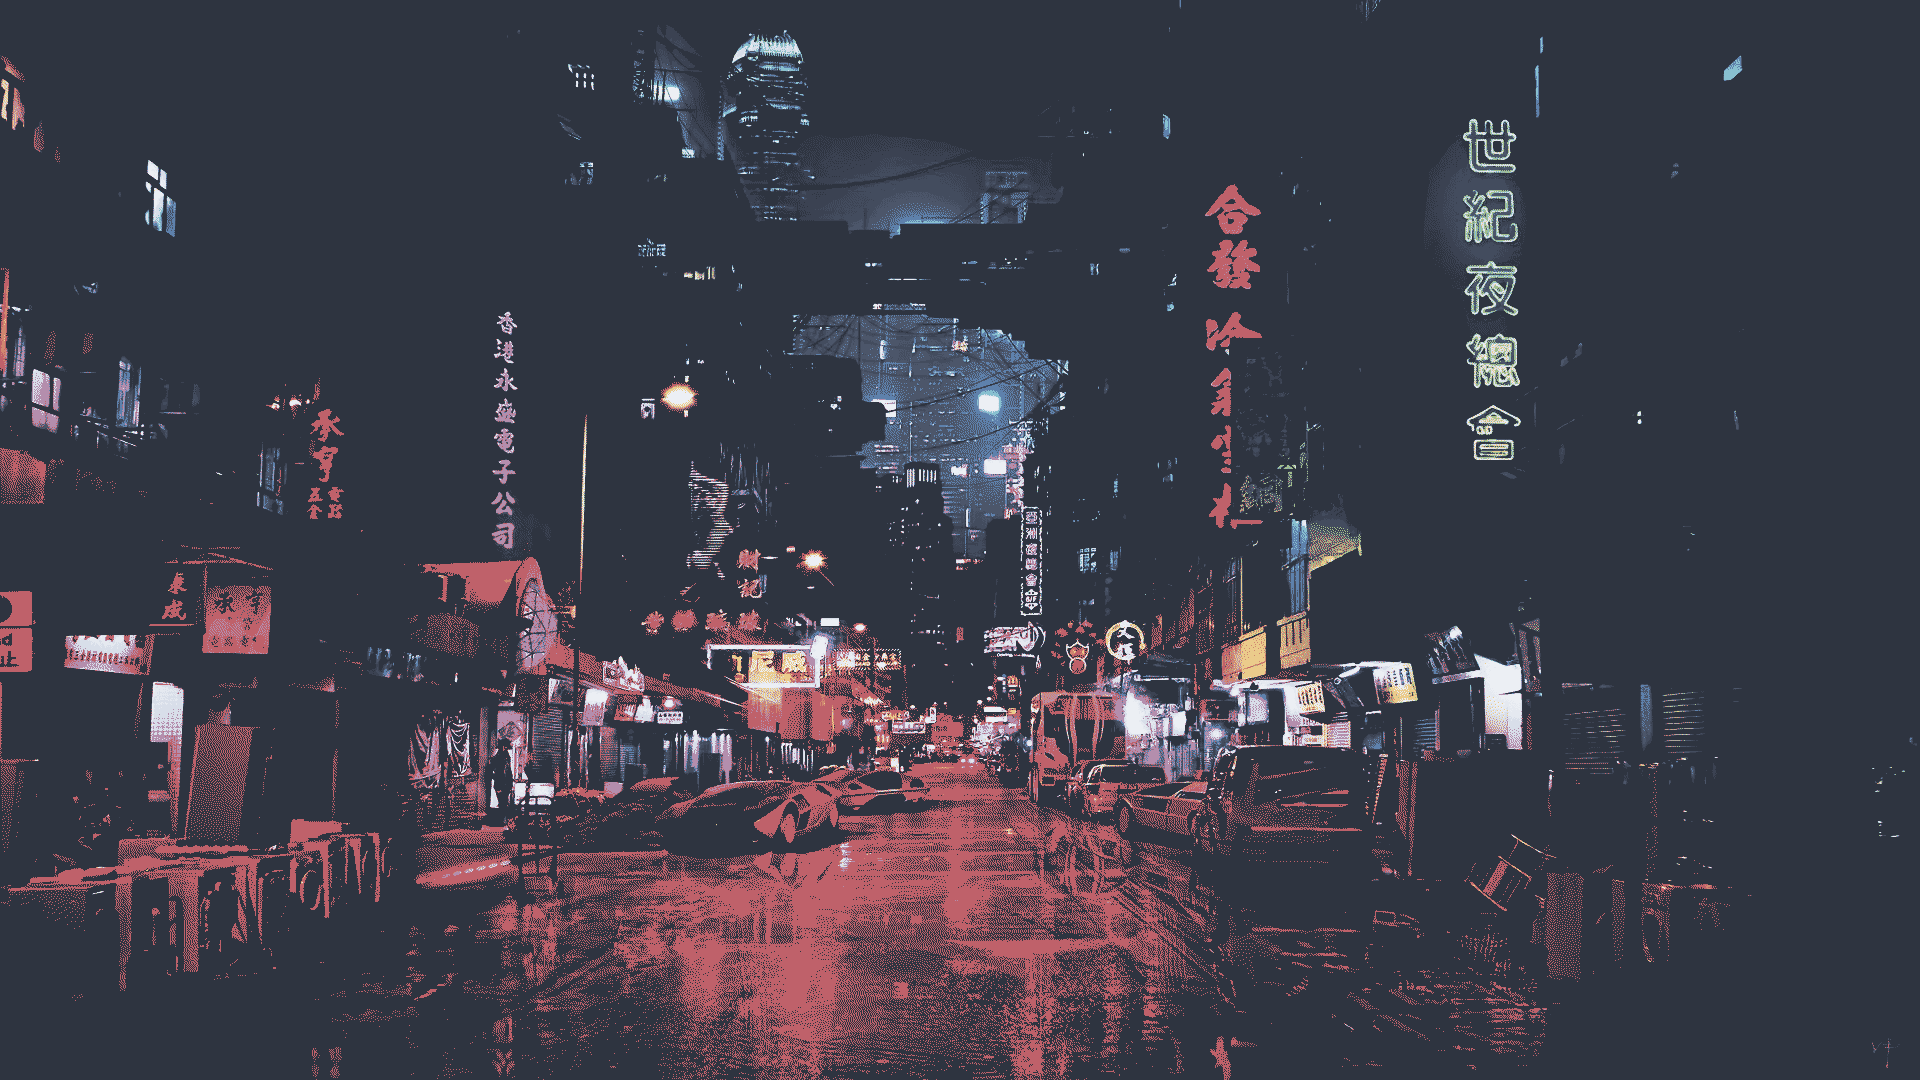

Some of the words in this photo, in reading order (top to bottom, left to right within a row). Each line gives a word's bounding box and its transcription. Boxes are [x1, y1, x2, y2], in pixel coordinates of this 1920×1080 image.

[1463, 118, 1522, 461] 世紀夜總會
